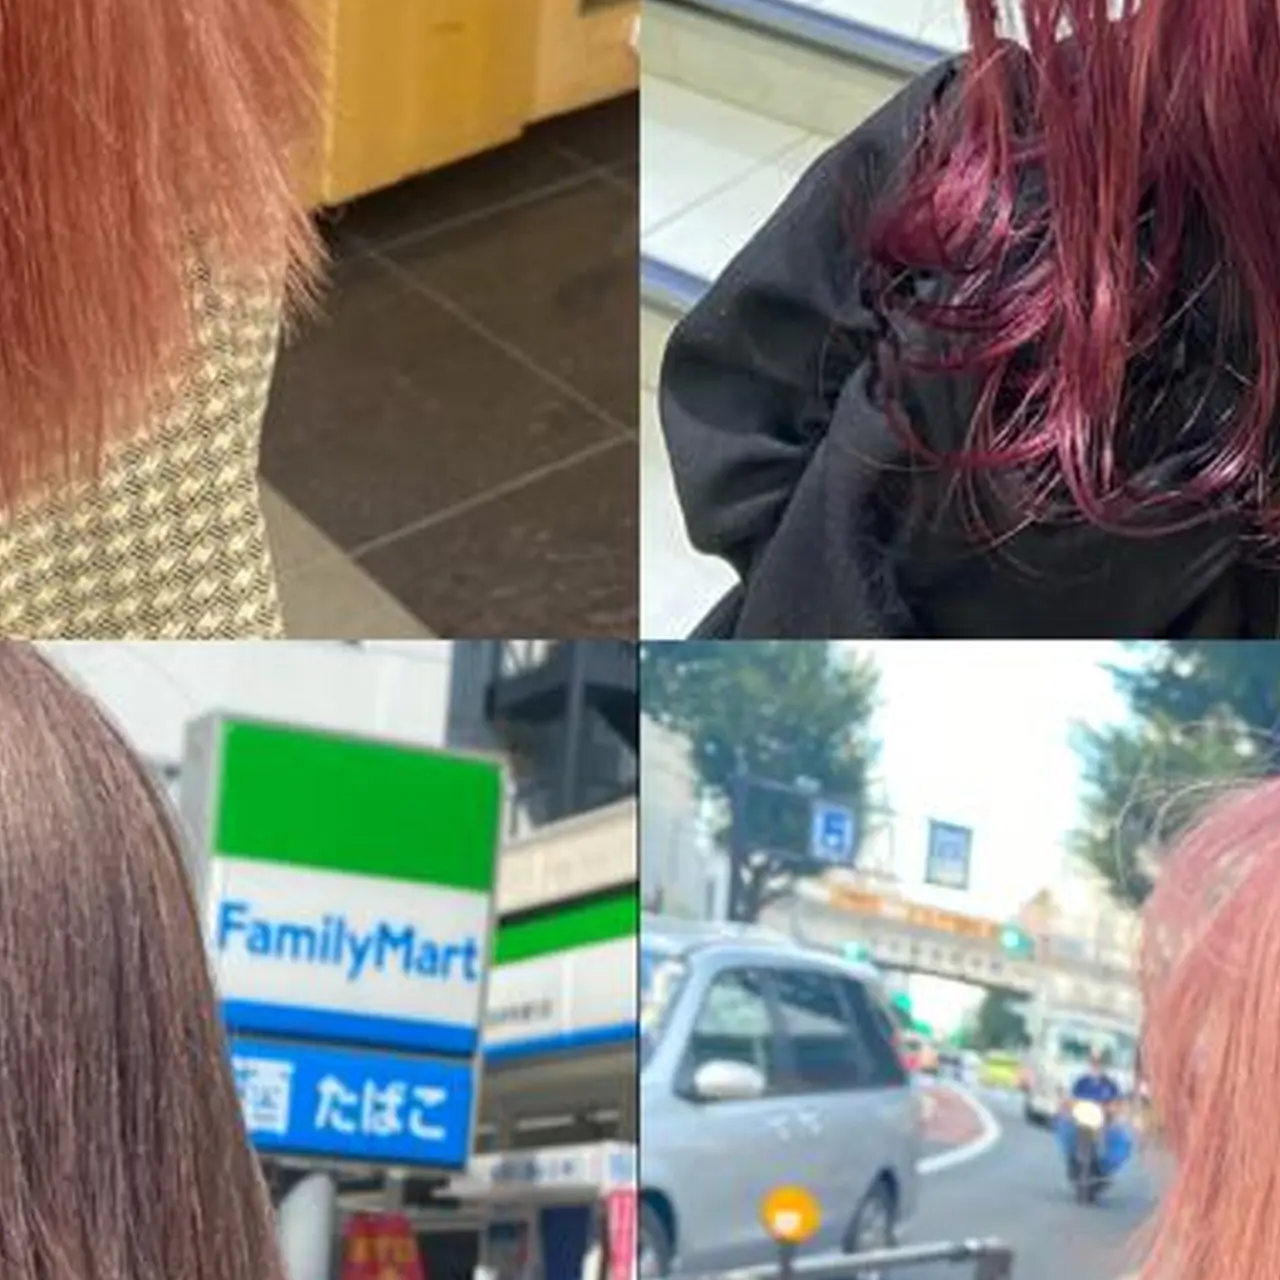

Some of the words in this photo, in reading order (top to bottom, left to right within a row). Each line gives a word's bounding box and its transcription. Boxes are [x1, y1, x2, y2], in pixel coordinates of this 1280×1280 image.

[217, 900, 477, 981] FamilyMart
[314, 1075, 448, 1140] たばこ
